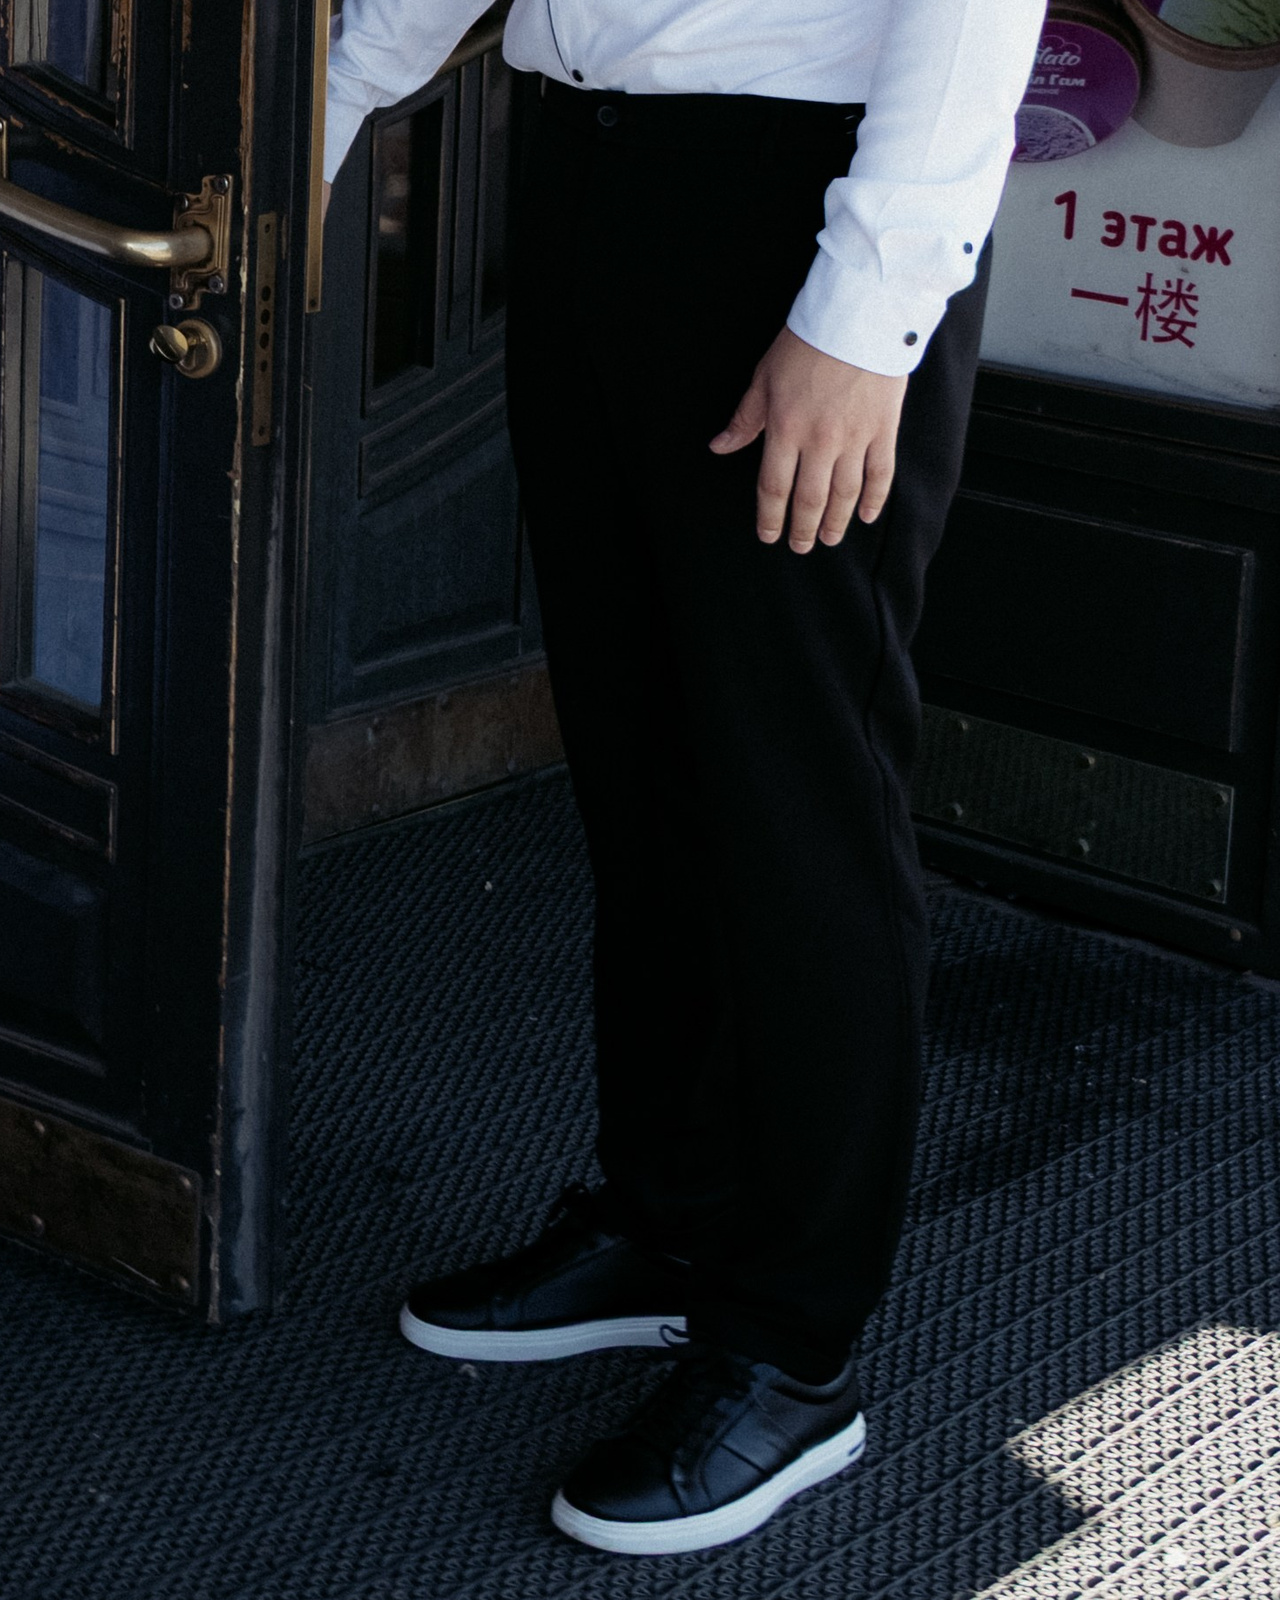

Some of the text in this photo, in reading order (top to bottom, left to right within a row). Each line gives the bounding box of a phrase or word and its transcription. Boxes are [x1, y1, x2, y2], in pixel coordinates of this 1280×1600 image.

[1036, 46, 1082, 66] lato
[1054, 190, 1235, 267] 1 этаж
[1070, 271, 1200, 349] 一楼
